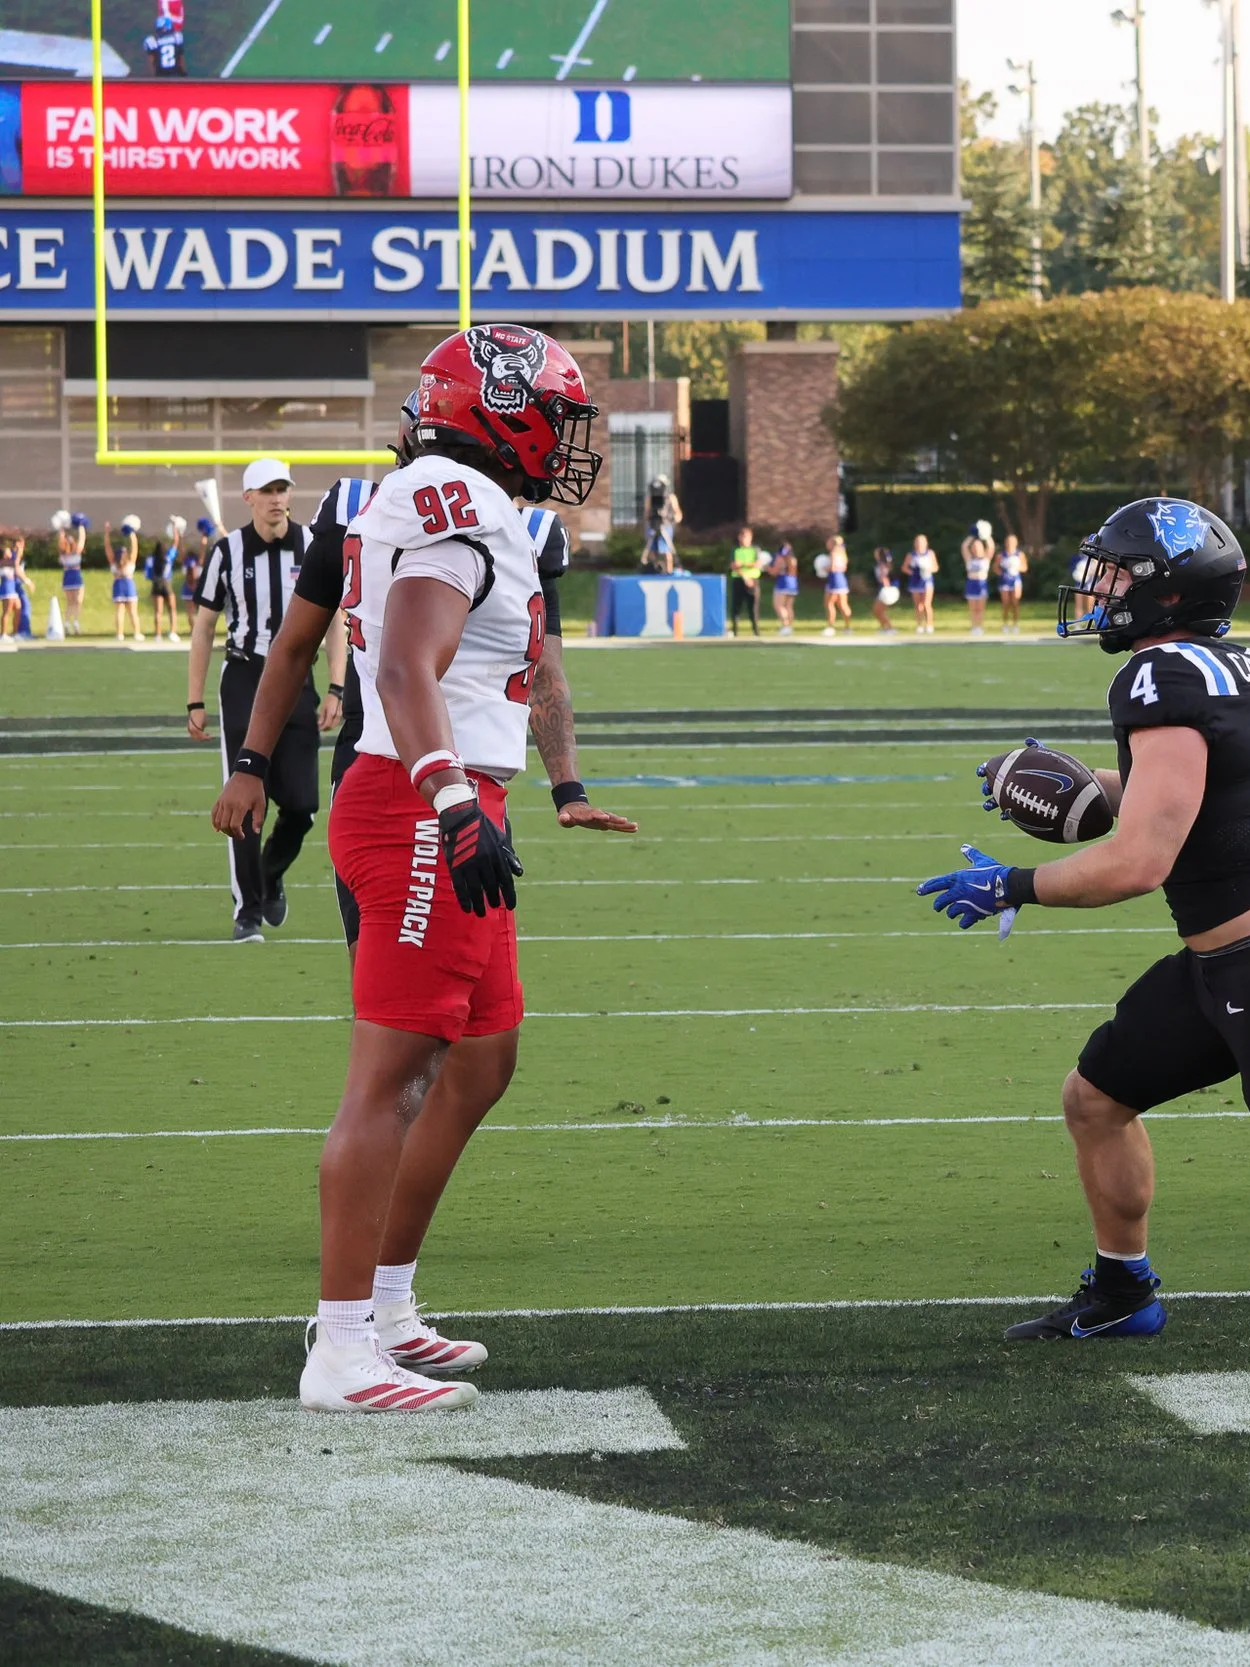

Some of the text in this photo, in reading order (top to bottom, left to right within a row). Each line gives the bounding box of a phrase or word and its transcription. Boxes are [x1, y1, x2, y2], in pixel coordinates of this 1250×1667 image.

[160, 44, 176, 68] 2
[46, 107, 300, 143] FAN WORK
[47, 147, 301, 169] IS THIRSTY WORK
[469, 156, 740, 190] IRON DUKES
[94, 228, 344, 290] WADE
[371, 226, 763, 292] STADIUM
[413, 480, 479, 534] 92
[1130, 661, 1159, 706] 4
[398, 818, 441, 949] WOLFPACK
